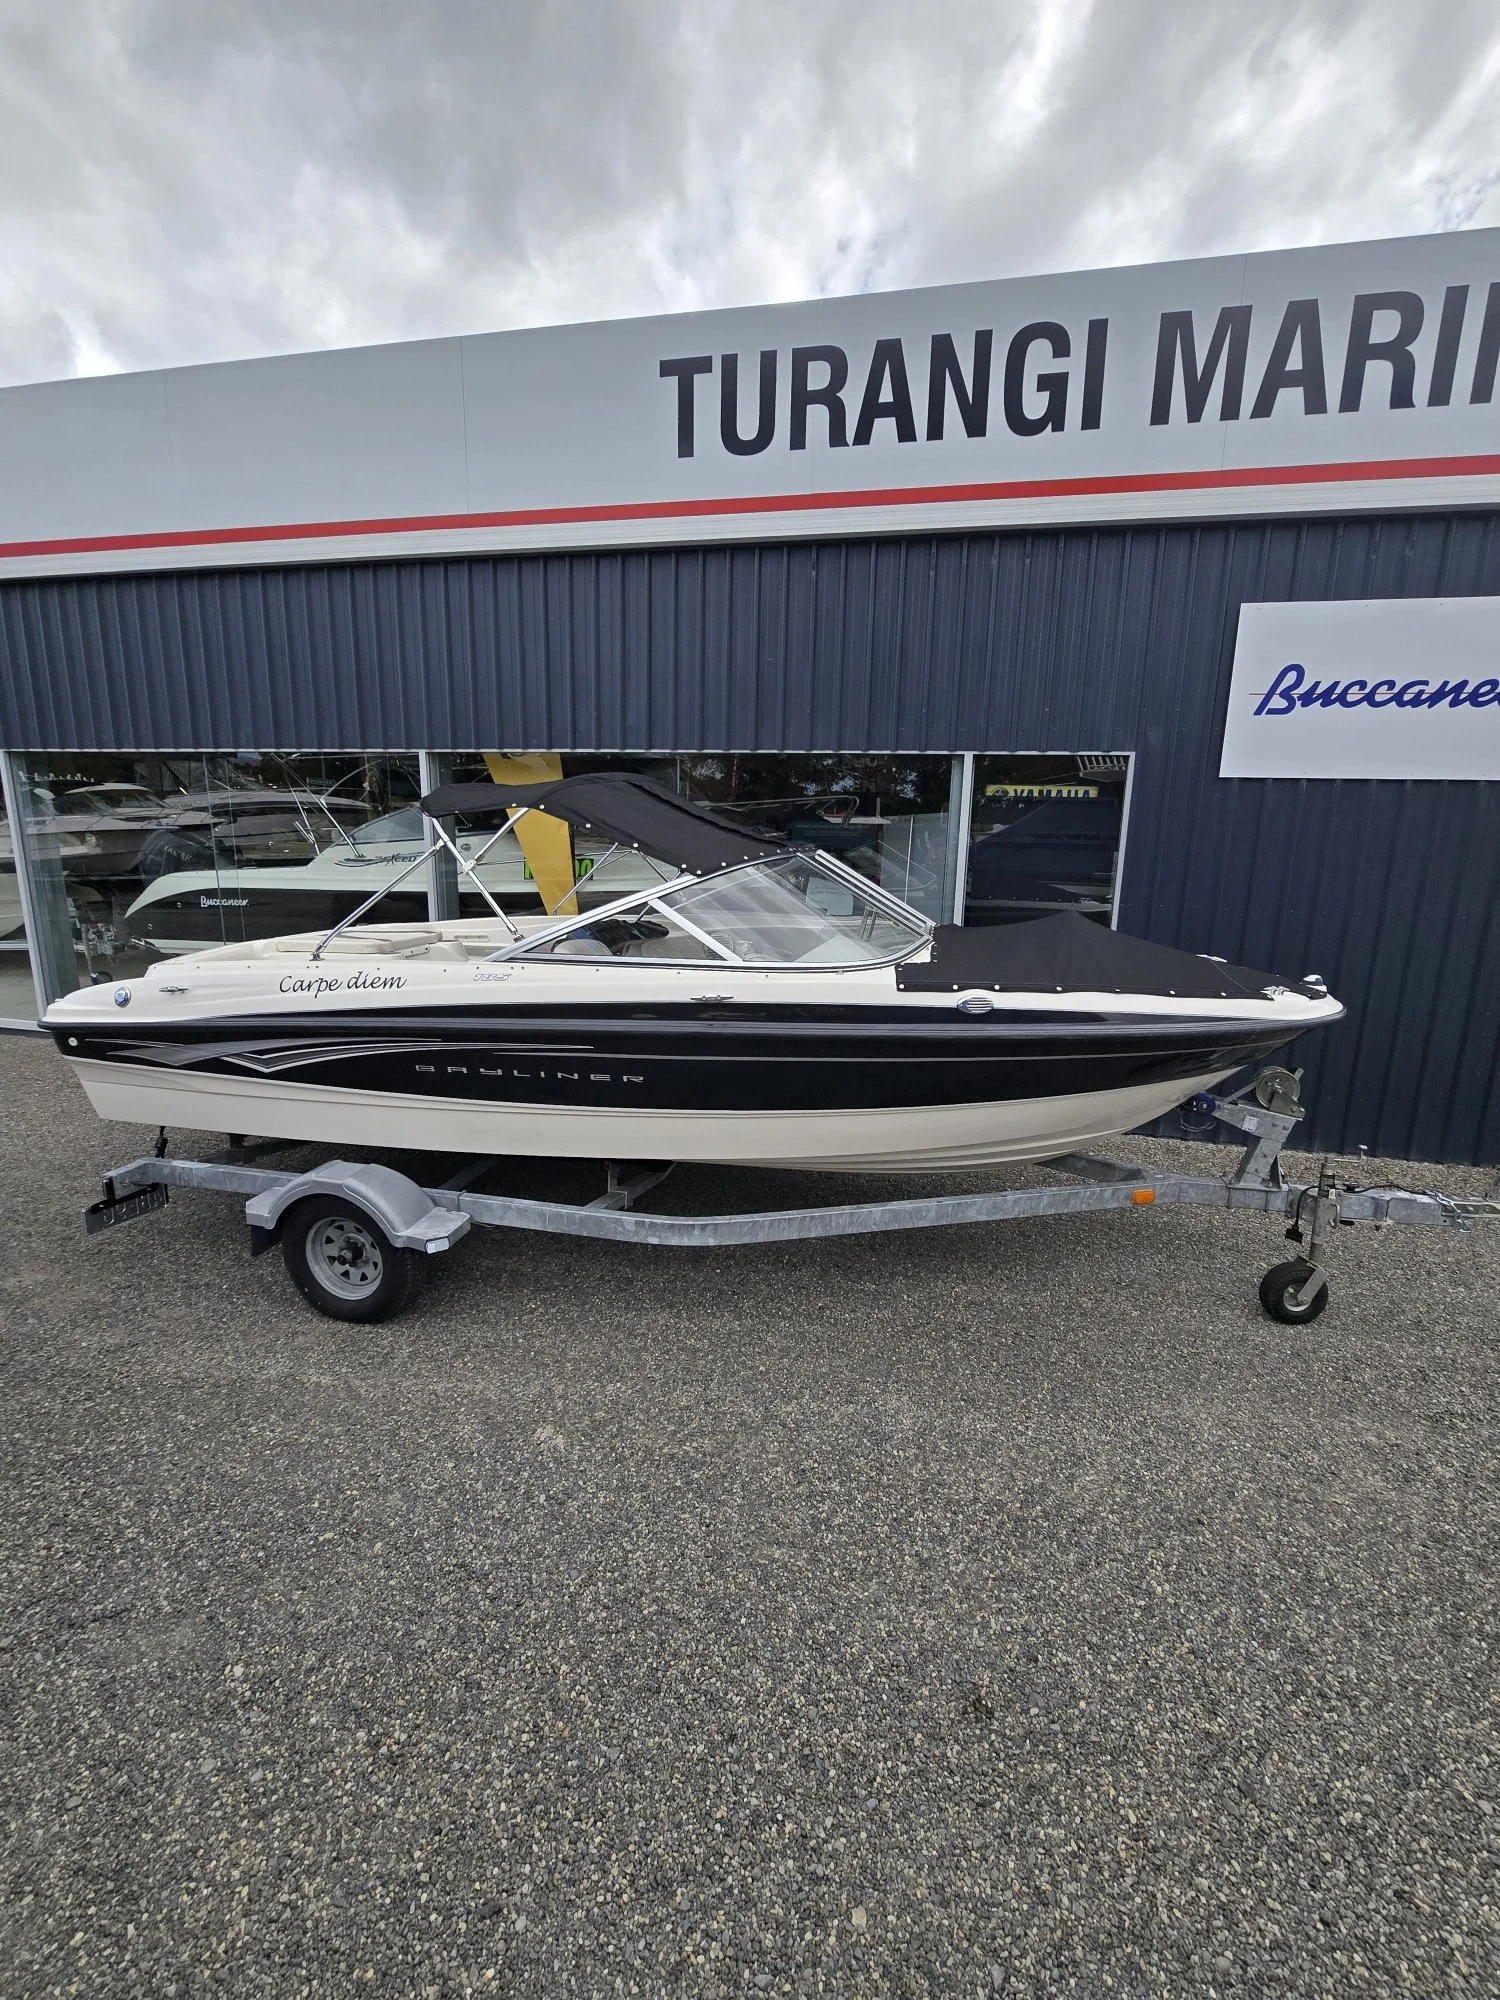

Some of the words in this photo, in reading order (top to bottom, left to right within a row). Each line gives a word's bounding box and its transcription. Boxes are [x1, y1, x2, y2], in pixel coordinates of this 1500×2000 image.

[660, 318, 1108, 459] TURANGI
[1253, 663, 1500, 716] Buccane
[200, 895, 248, 907] Buccaneer
[279, 975, 343, 998] Carpe
[346, 971, 407, 989] diem
[415, 1064, 644, 1083] BAYLINER
